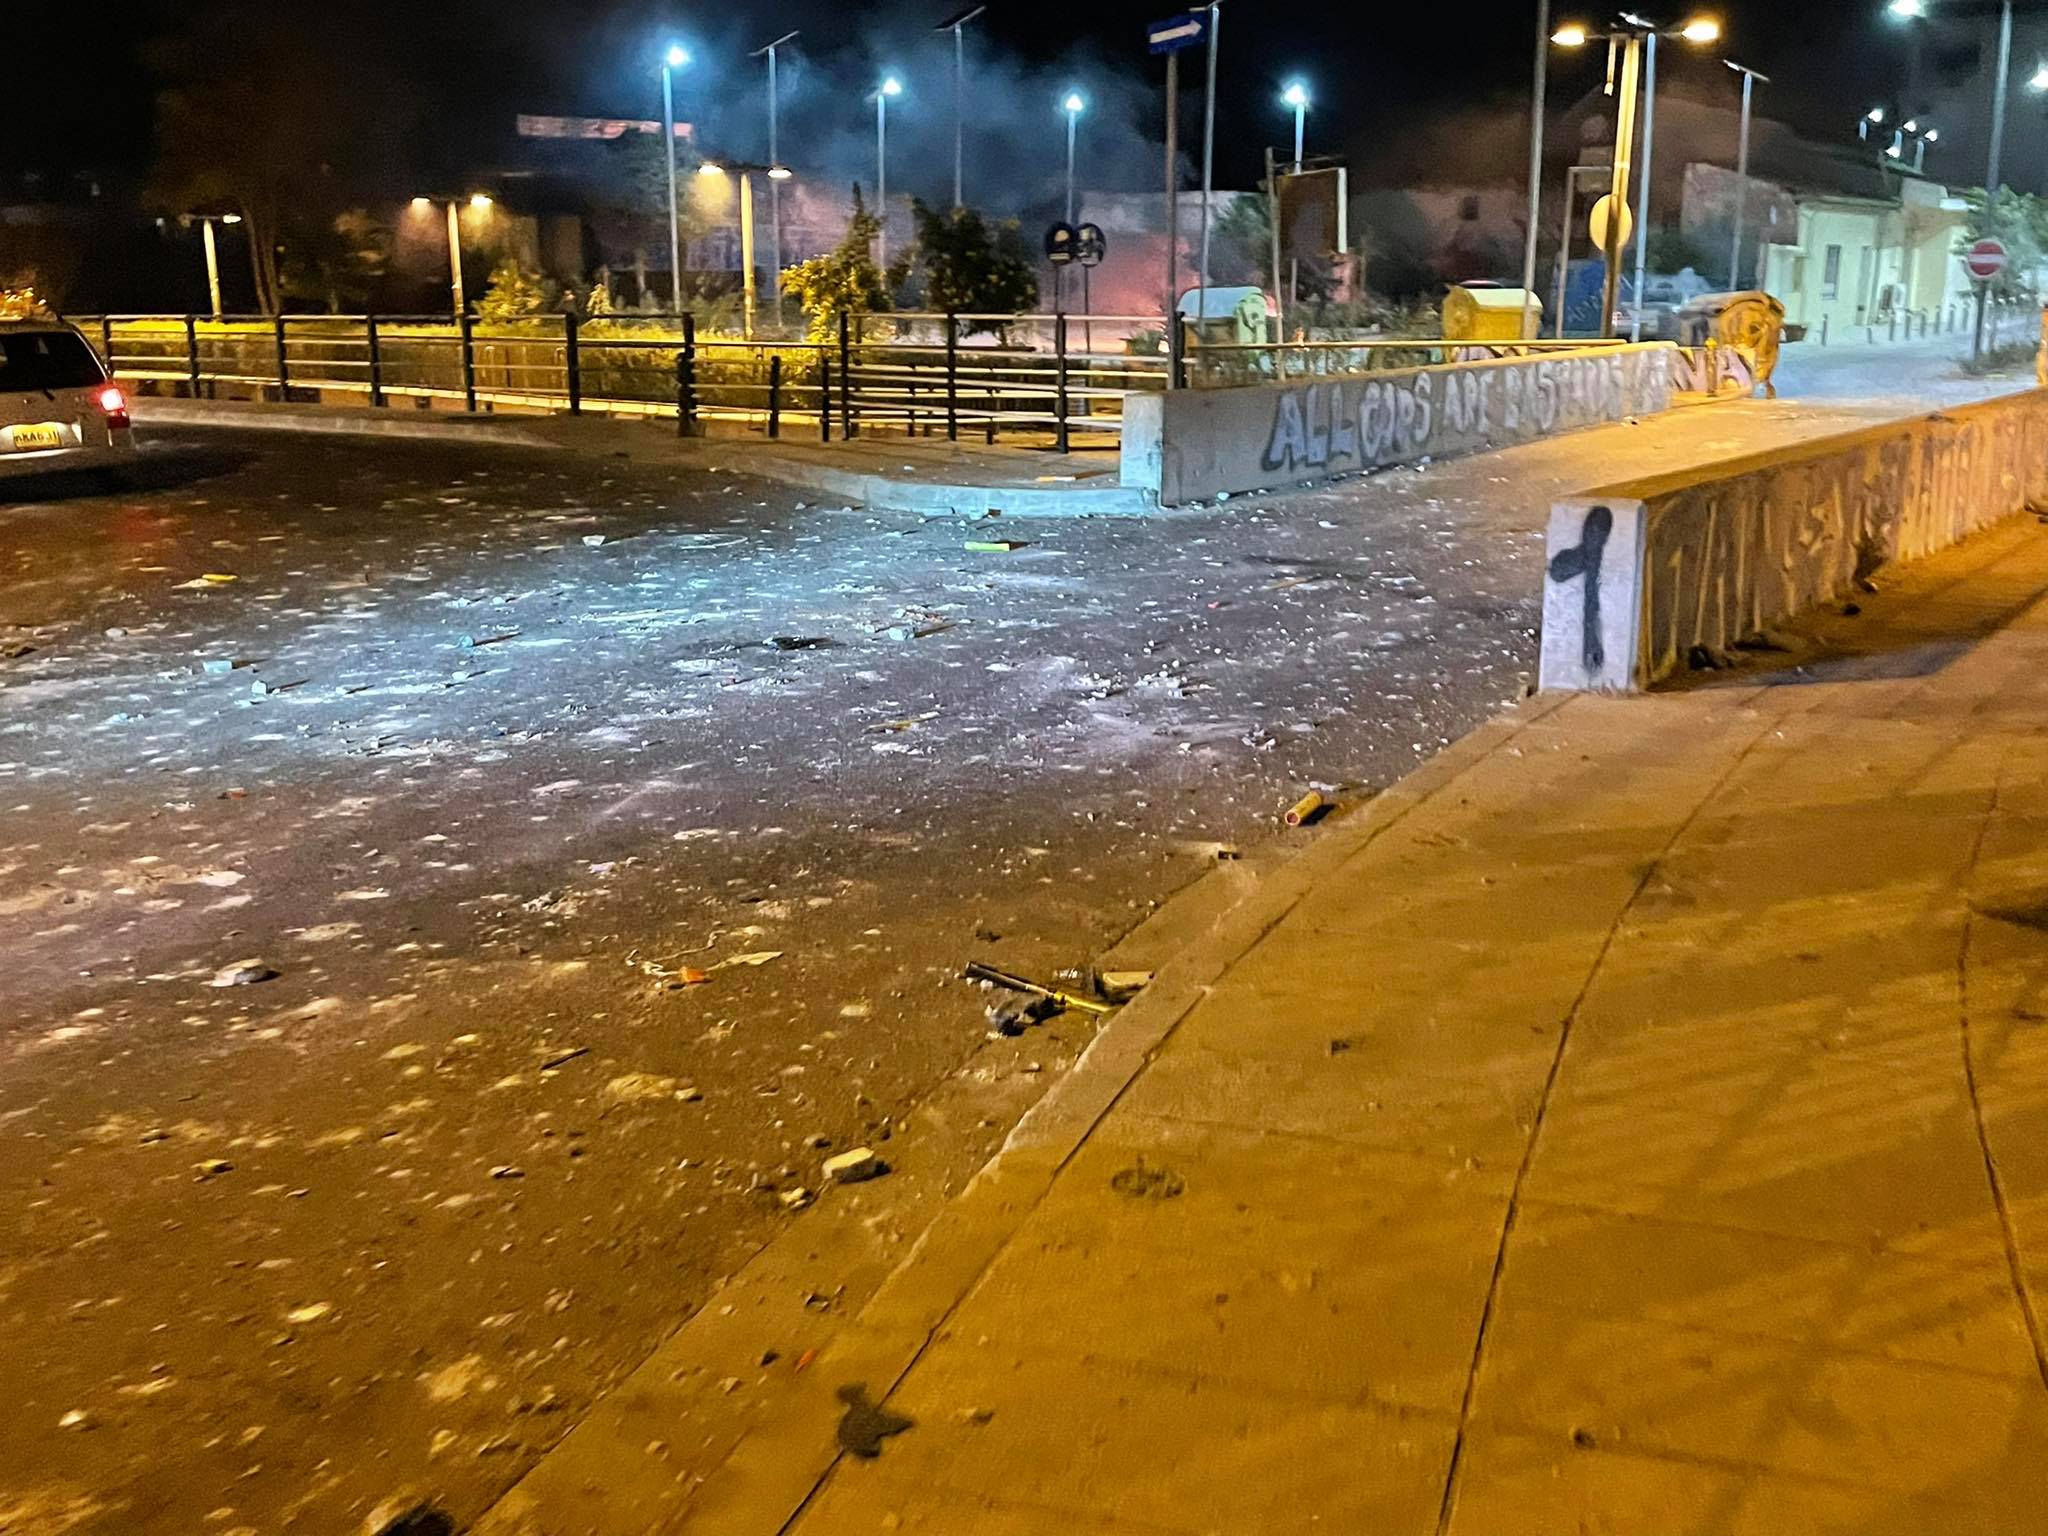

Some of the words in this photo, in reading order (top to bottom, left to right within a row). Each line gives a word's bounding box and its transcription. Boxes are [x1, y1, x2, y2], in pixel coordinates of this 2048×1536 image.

[1262, 383, 1354, 473] ALL
[1360, 371, 1435, 463] COPS
[1443, 367, 1495, 433] ARE
